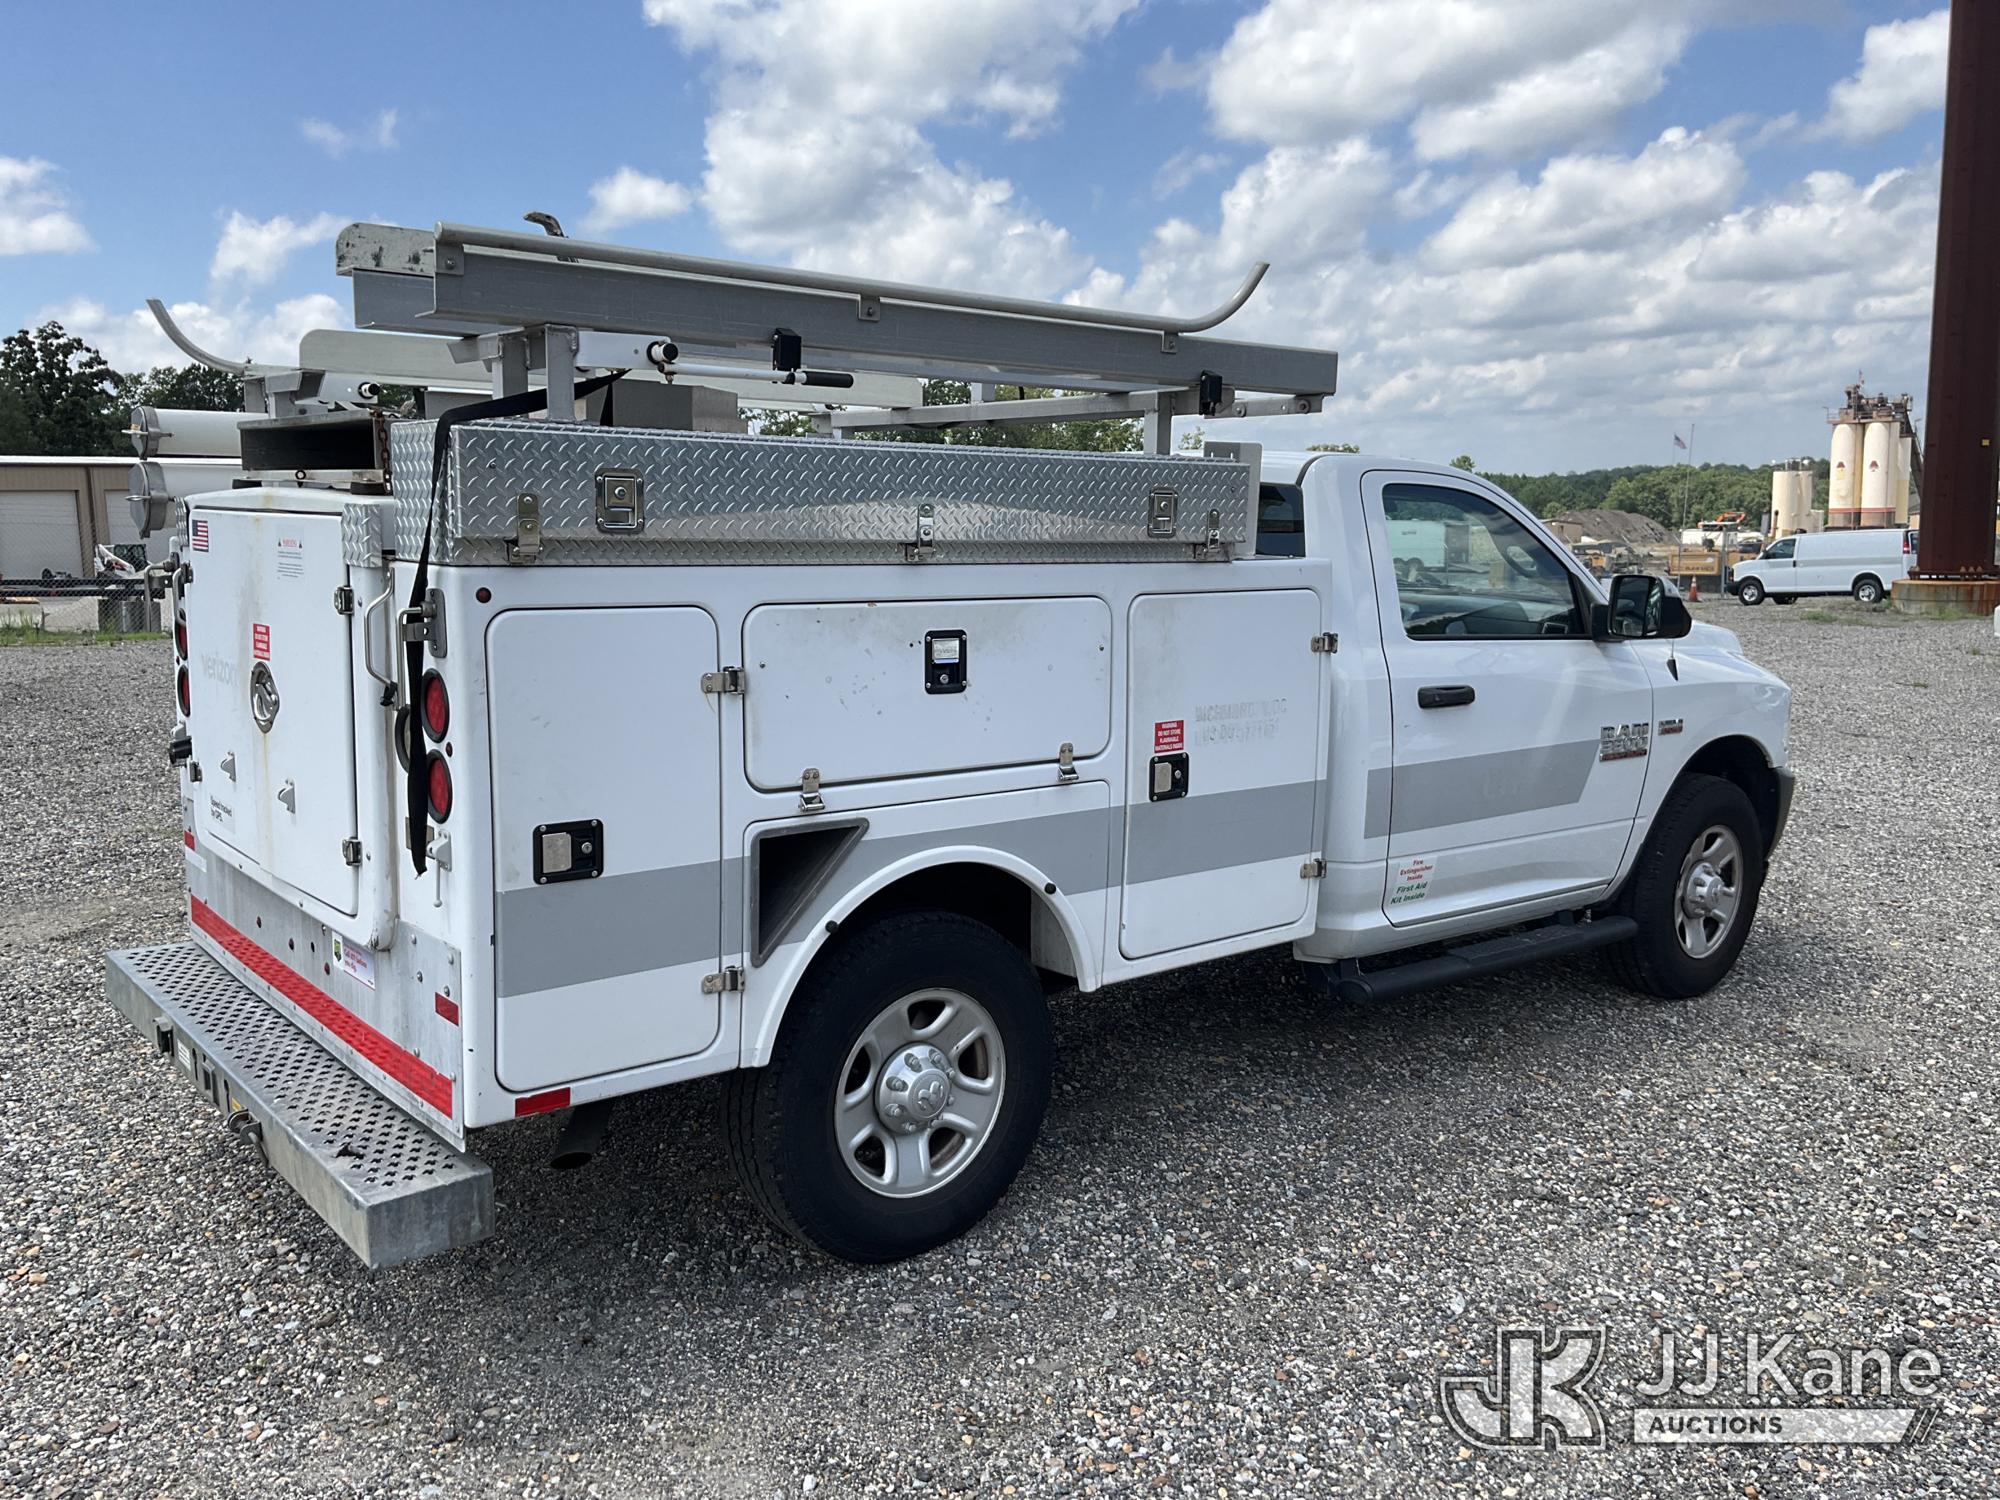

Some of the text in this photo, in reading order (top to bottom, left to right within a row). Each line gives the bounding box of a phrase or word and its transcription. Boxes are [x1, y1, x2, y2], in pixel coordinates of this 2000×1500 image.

[1600, 723, 1649, 740] RAM
[1396, 881, 1428, 894] First Aid
[1390, 892, 1425, 905] Kit Inside
